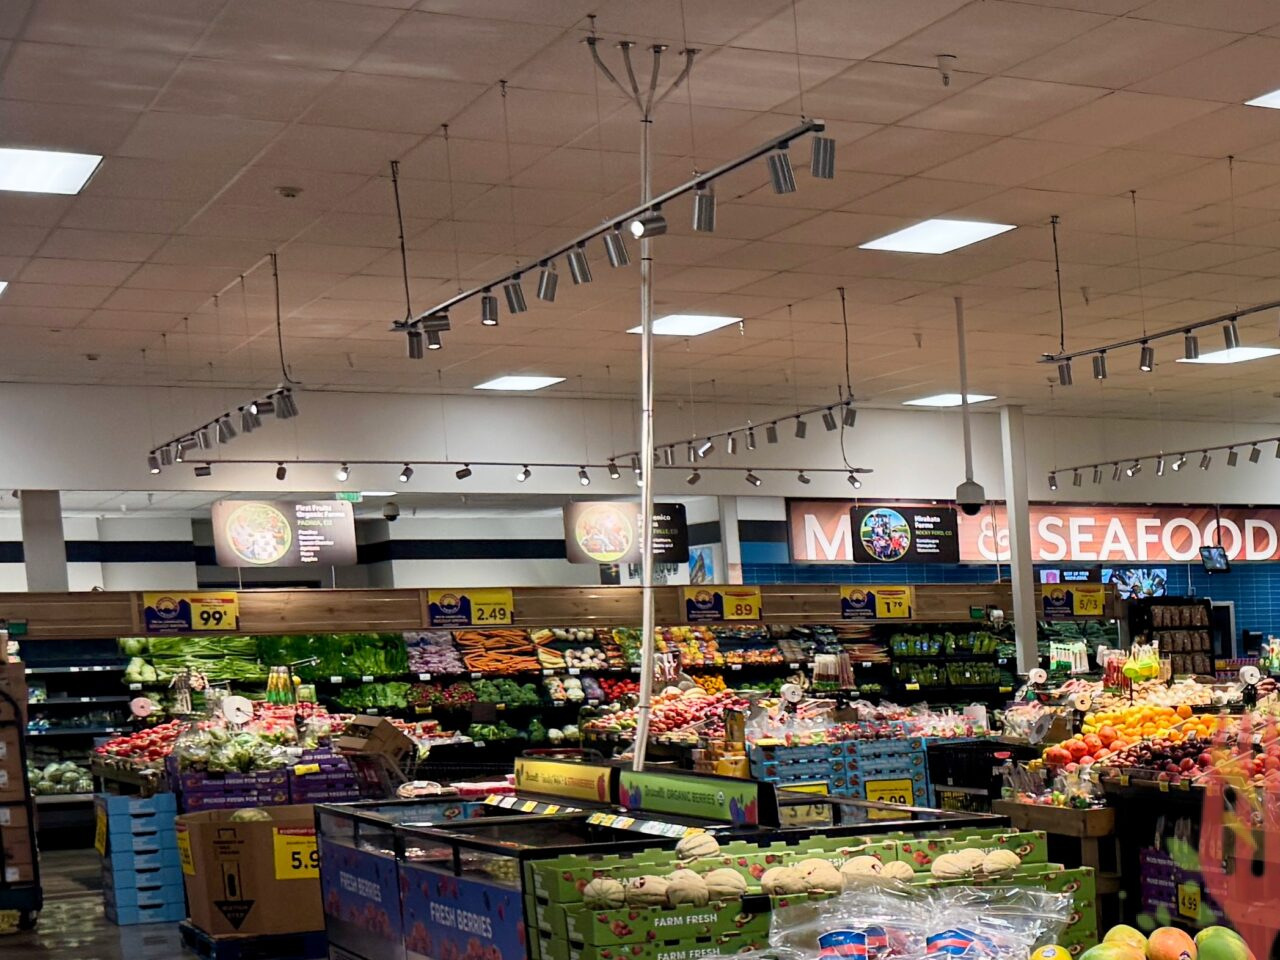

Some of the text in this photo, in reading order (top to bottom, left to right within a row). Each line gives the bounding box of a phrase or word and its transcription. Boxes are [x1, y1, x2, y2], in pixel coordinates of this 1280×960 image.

[1038, 516, 1278, 561] SEAFOOD
[476, 608, 507, 621] 2.49
[339, 871, 382, 903] FRESH BERRIES
[429, 901, 493, 939] FRESH BERRIES
[654, 913, 718, 928] FARM FRESH
[687, 947, 721, 960] FRESH
